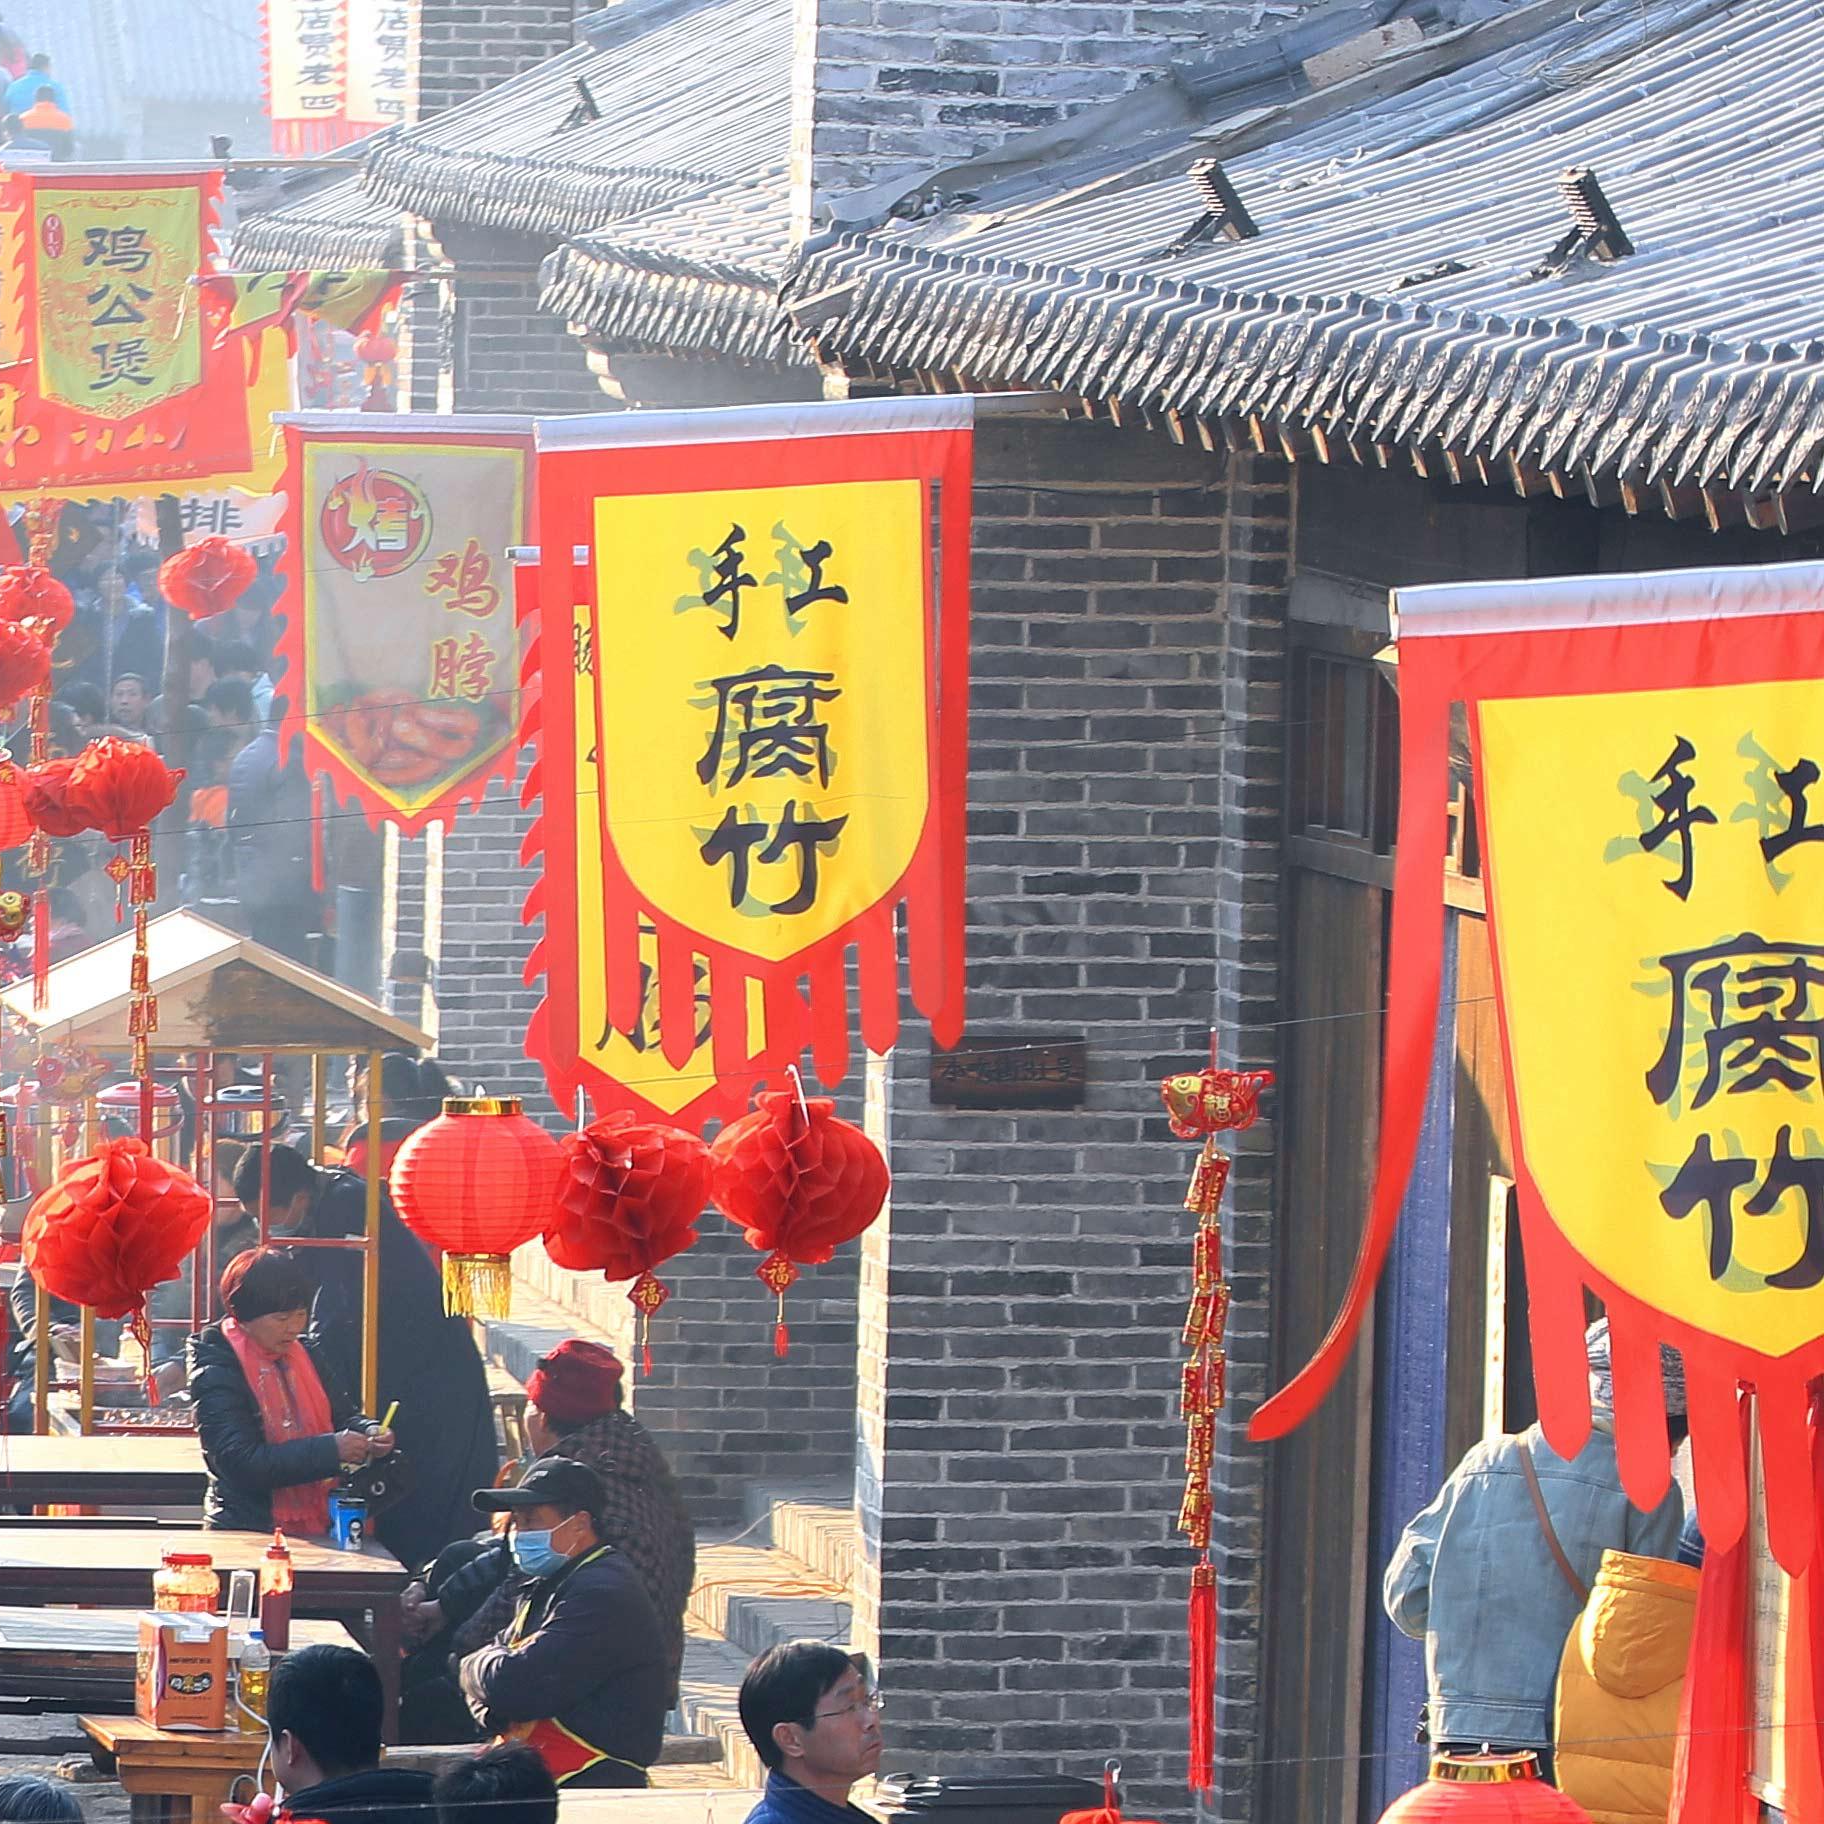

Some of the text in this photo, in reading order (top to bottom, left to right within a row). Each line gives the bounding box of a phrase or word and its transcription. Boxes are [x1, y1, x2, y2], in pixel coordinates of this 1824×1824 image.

[83, 225, 156, 391] 鸡公煲
[425, 540, 501, 702] 鸡脖
[701, 521, 850, 641] 手工
[696, 663, 850, 916] 腐竹
